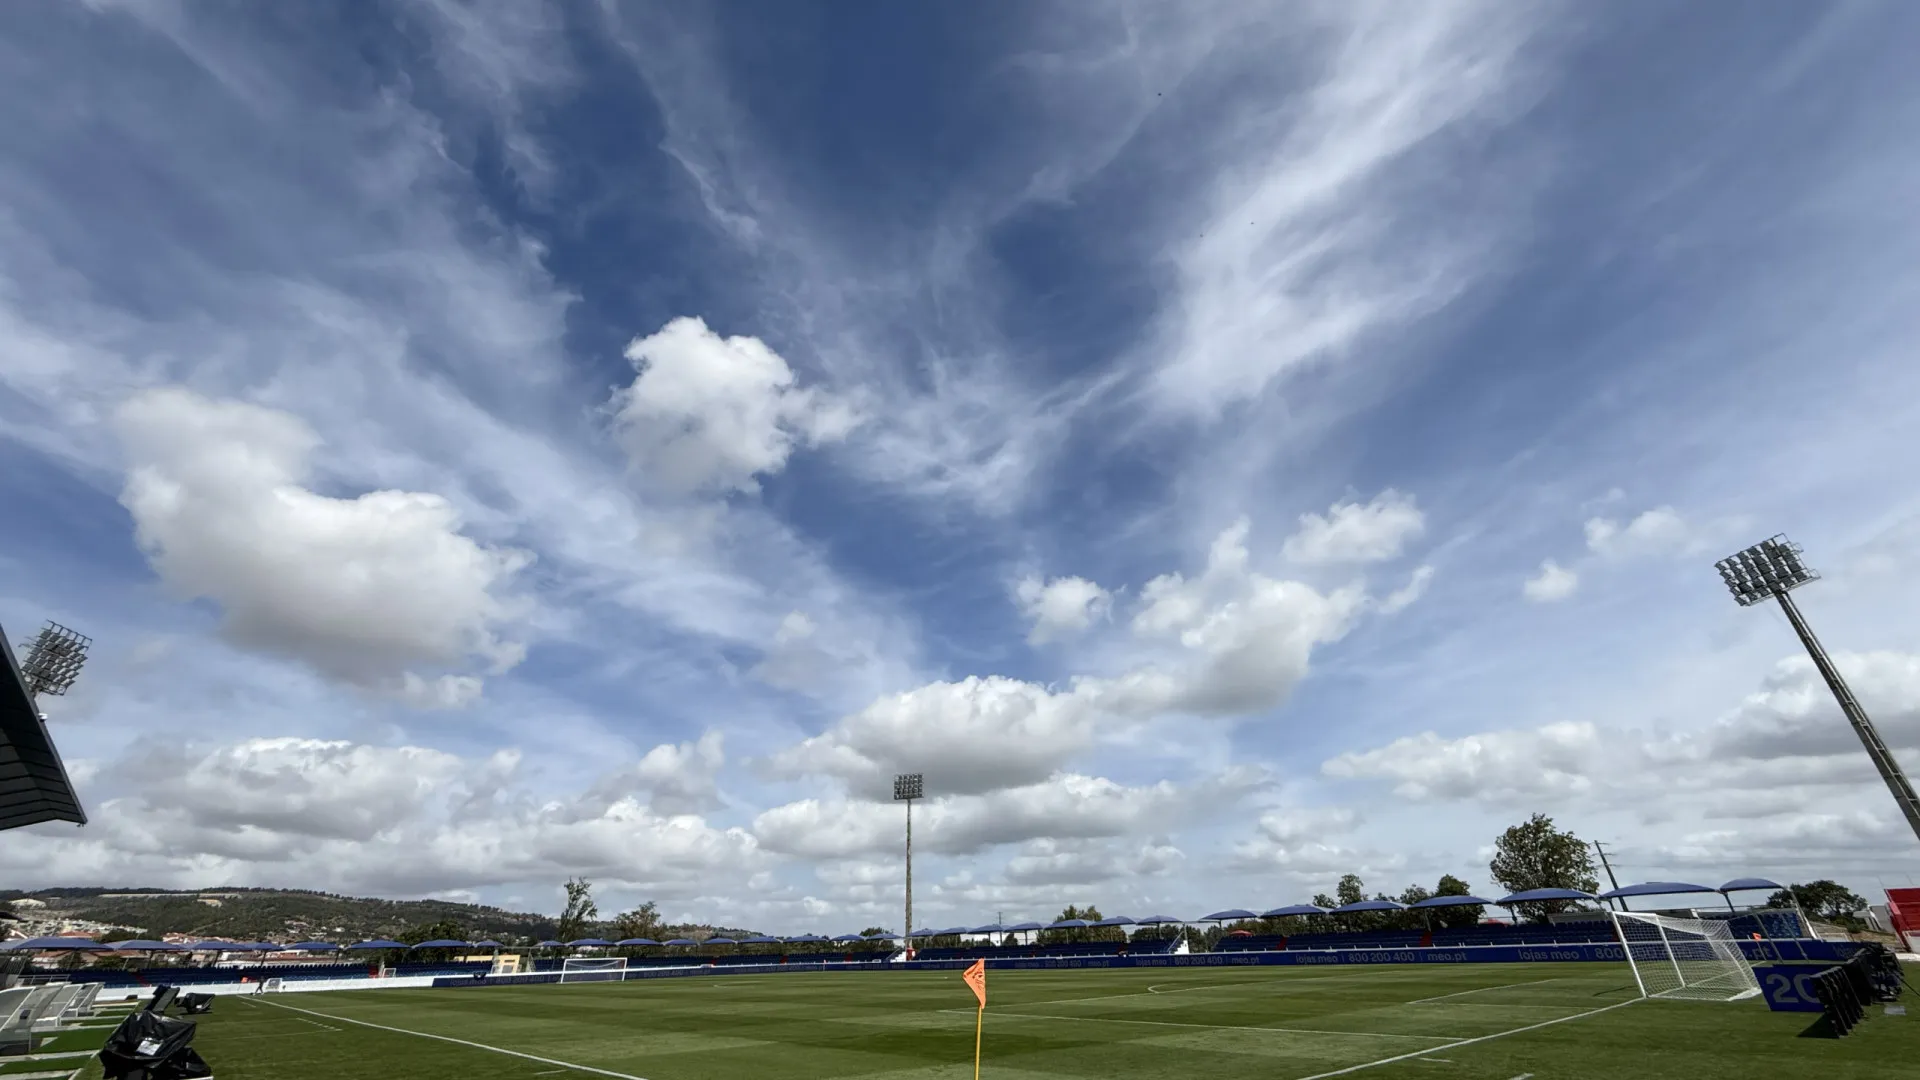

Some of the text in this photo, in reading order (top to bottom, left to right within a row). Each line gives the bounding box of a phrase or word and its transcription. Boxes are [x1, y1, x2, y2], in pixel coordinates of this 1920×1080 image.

[1296, 951, 1468, 964] lojas meo 800 200 400 meo.pt
[1517, 949, 1548, 962] lojas
[1550, 949, 1580, 961] meo
[1594, 947, 1625, 960] 800
[1136, 958, 1151, 967] lojas
[1174, 957, 1189, 966] 800
[1191, 957, 1206, 965] 200
[1207, 957, 1223, 965] 400
[1231, 956, 1260, 965] meo.pt
